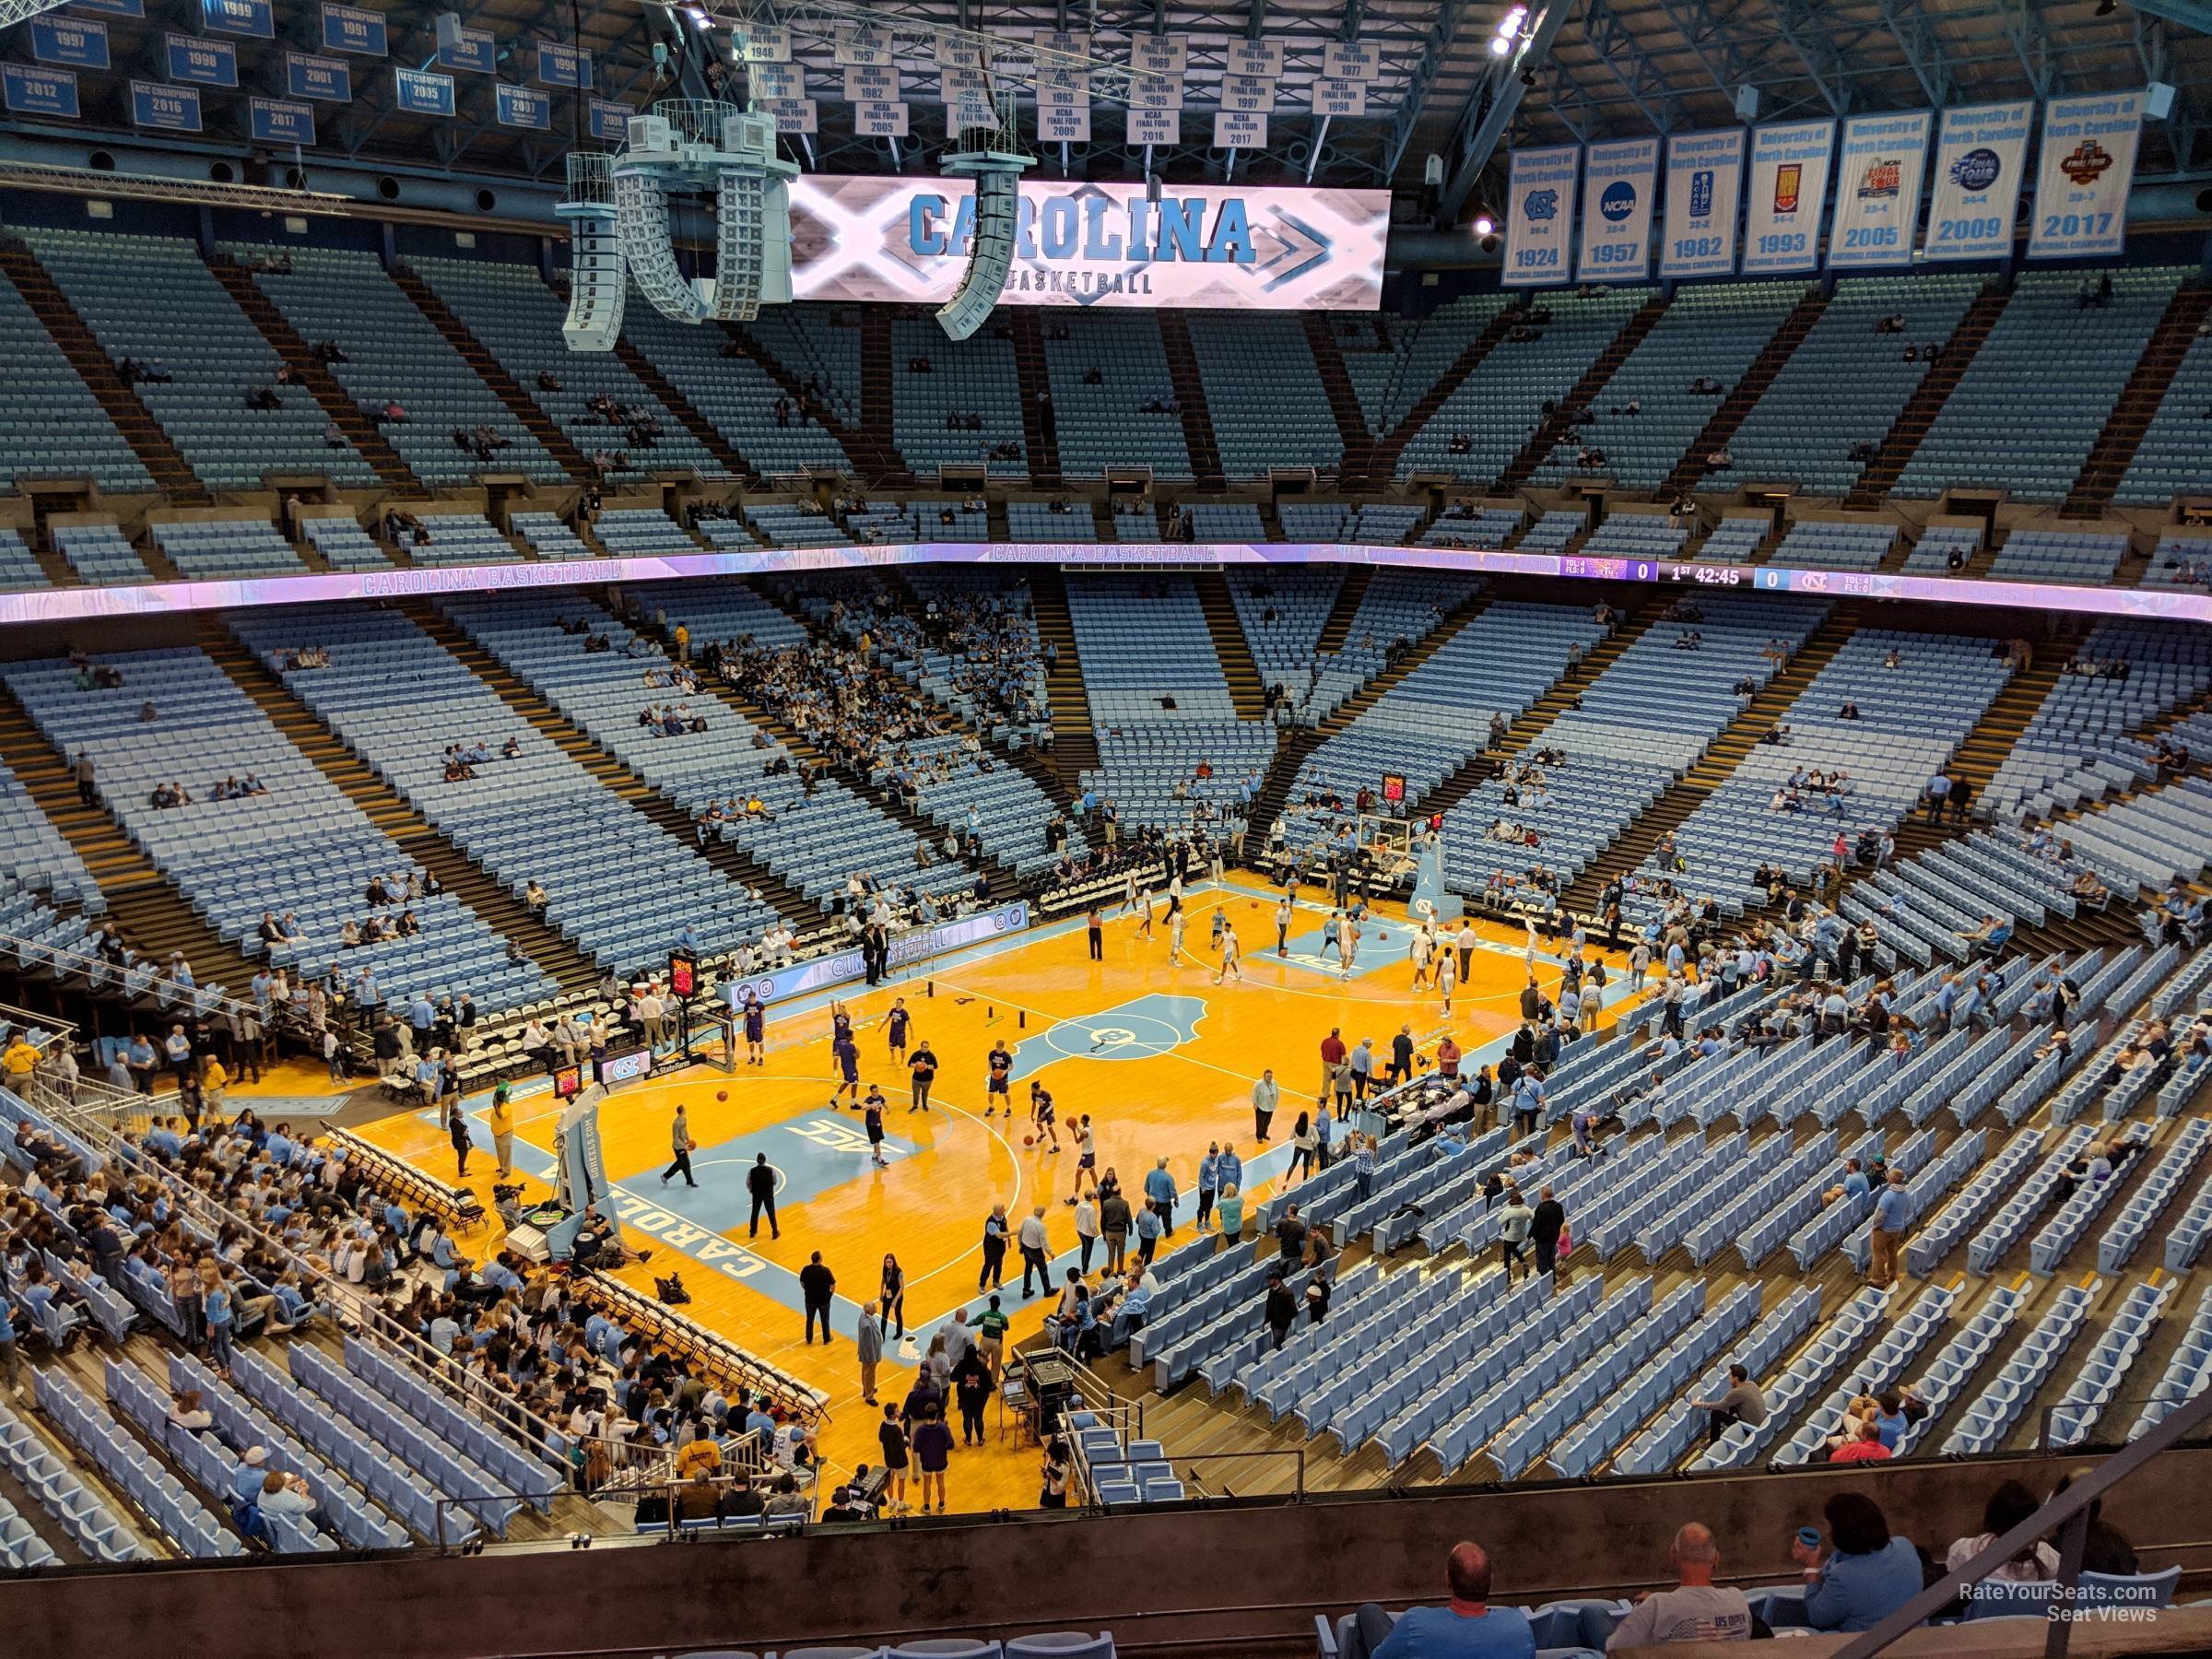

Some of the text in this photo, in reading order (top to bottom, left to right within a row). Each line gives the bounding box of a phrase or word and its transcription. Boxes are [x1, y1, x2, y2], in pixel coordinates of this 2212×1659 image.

[324, 8, 383, 24] ACC CHAMPIONS
[343, 21, 368, 37] 1991
[56, 32, 85, 48] 1997
[752, 47, 773, 57] 1946
[853, 51, 874, 62] 1957
[1160, 46, 1178, 54] FOUR
[189, 52, 218, 67] 1998
[554, 58, 577, 72] 1994
[1147, 57, 1170, 67] 1969
[1245, 62, 1265, 73] 1972
[1342, 65, 1360, 76] 1977
[306, 69, 332, 84] 2001
[853, 76, 871, 85] FINAL
[24, 81, 57, 97] 2012
[413, 85, 438, 100] 2005
[1231, 87, 1248, 95] FINAL
[1340, 91, 1357, 100] FOUR
[152, 98, 182, 113] 2016
[1052, 93, 1074, 103] 1993
[1146, 96, 1167, 106] 1995
[1237, 98, 1258, 109] 1997
[512, 100, 535, 113] 2007
[791, 109, 807, 117] FOUR
[1328, 102, 1349, 112] 1998
[2055, 99, 2136, 119] University of
[271, 112, 295, 127] 2017
[865, 112, 881, 120] FINAL
[1065, 117, 1081, 125] FOUR
[1950, 107, 2023, 126] University of
[780, 120, 801, 129] 2000
[871, 123, 893, 133] 2005
[1053, 126, 1076, 136] 2009
[1853, 119, 1922, 136] University of
[2047, 119, 2137, 137] North Carolina
[1143, 131, 1165, 141] 2016
[1230, 134, 1252, 144] 2017
[1761, 127, 1827, 146] University of
[1944, 127, 2026, 144] North Carolina
[1676, 136, 1737, 154] University of
[1847, 138, 1924, 155] North Carolina
[1593, 145, 1652, 161] University of
[1756, 147, 1828, 163] North Carolina
[1614, 161, 1653, 176] Carolina
[1698, 154, 1738, 168] Carolina
[1970, 158, 1995, 169] FINAL
[1868, 167, 1900, 177] FINAL
[1960, 167, 1994, 179] FOUR
[1604, 199, 1637, 212] NCAA
[1938, 218, 2002, 241] 2009
[2043, 213, 2113, 237] 2017
[1758, 233, 1806, 253] 1993
[1845, 227, 1898, 247] 2005
[1592, 243, 1637, 264] 1957
[1674, 237, 1723, 258] 1982
[1516, 248, 1559, 267] 1924
[993, 544, 1215, 561] CAROLINA BASKETBALL
[361, 559, 621, 595] CAROLINA BASKETBALL
[1638, 564, 1648, 579] 0
[1672, 566, 1739, 585] 1ST 42:45
[1767, 571, 1778, 587] 0
[1845, 576, 1862, 584] TOL:
[1387, 785, 1401, 798] 30
[585, 1119, 599, 1179] GOHEELS.COM
[773, 1435, 784, 1450] 52
[1715, 1616, 1727, 1627] US
